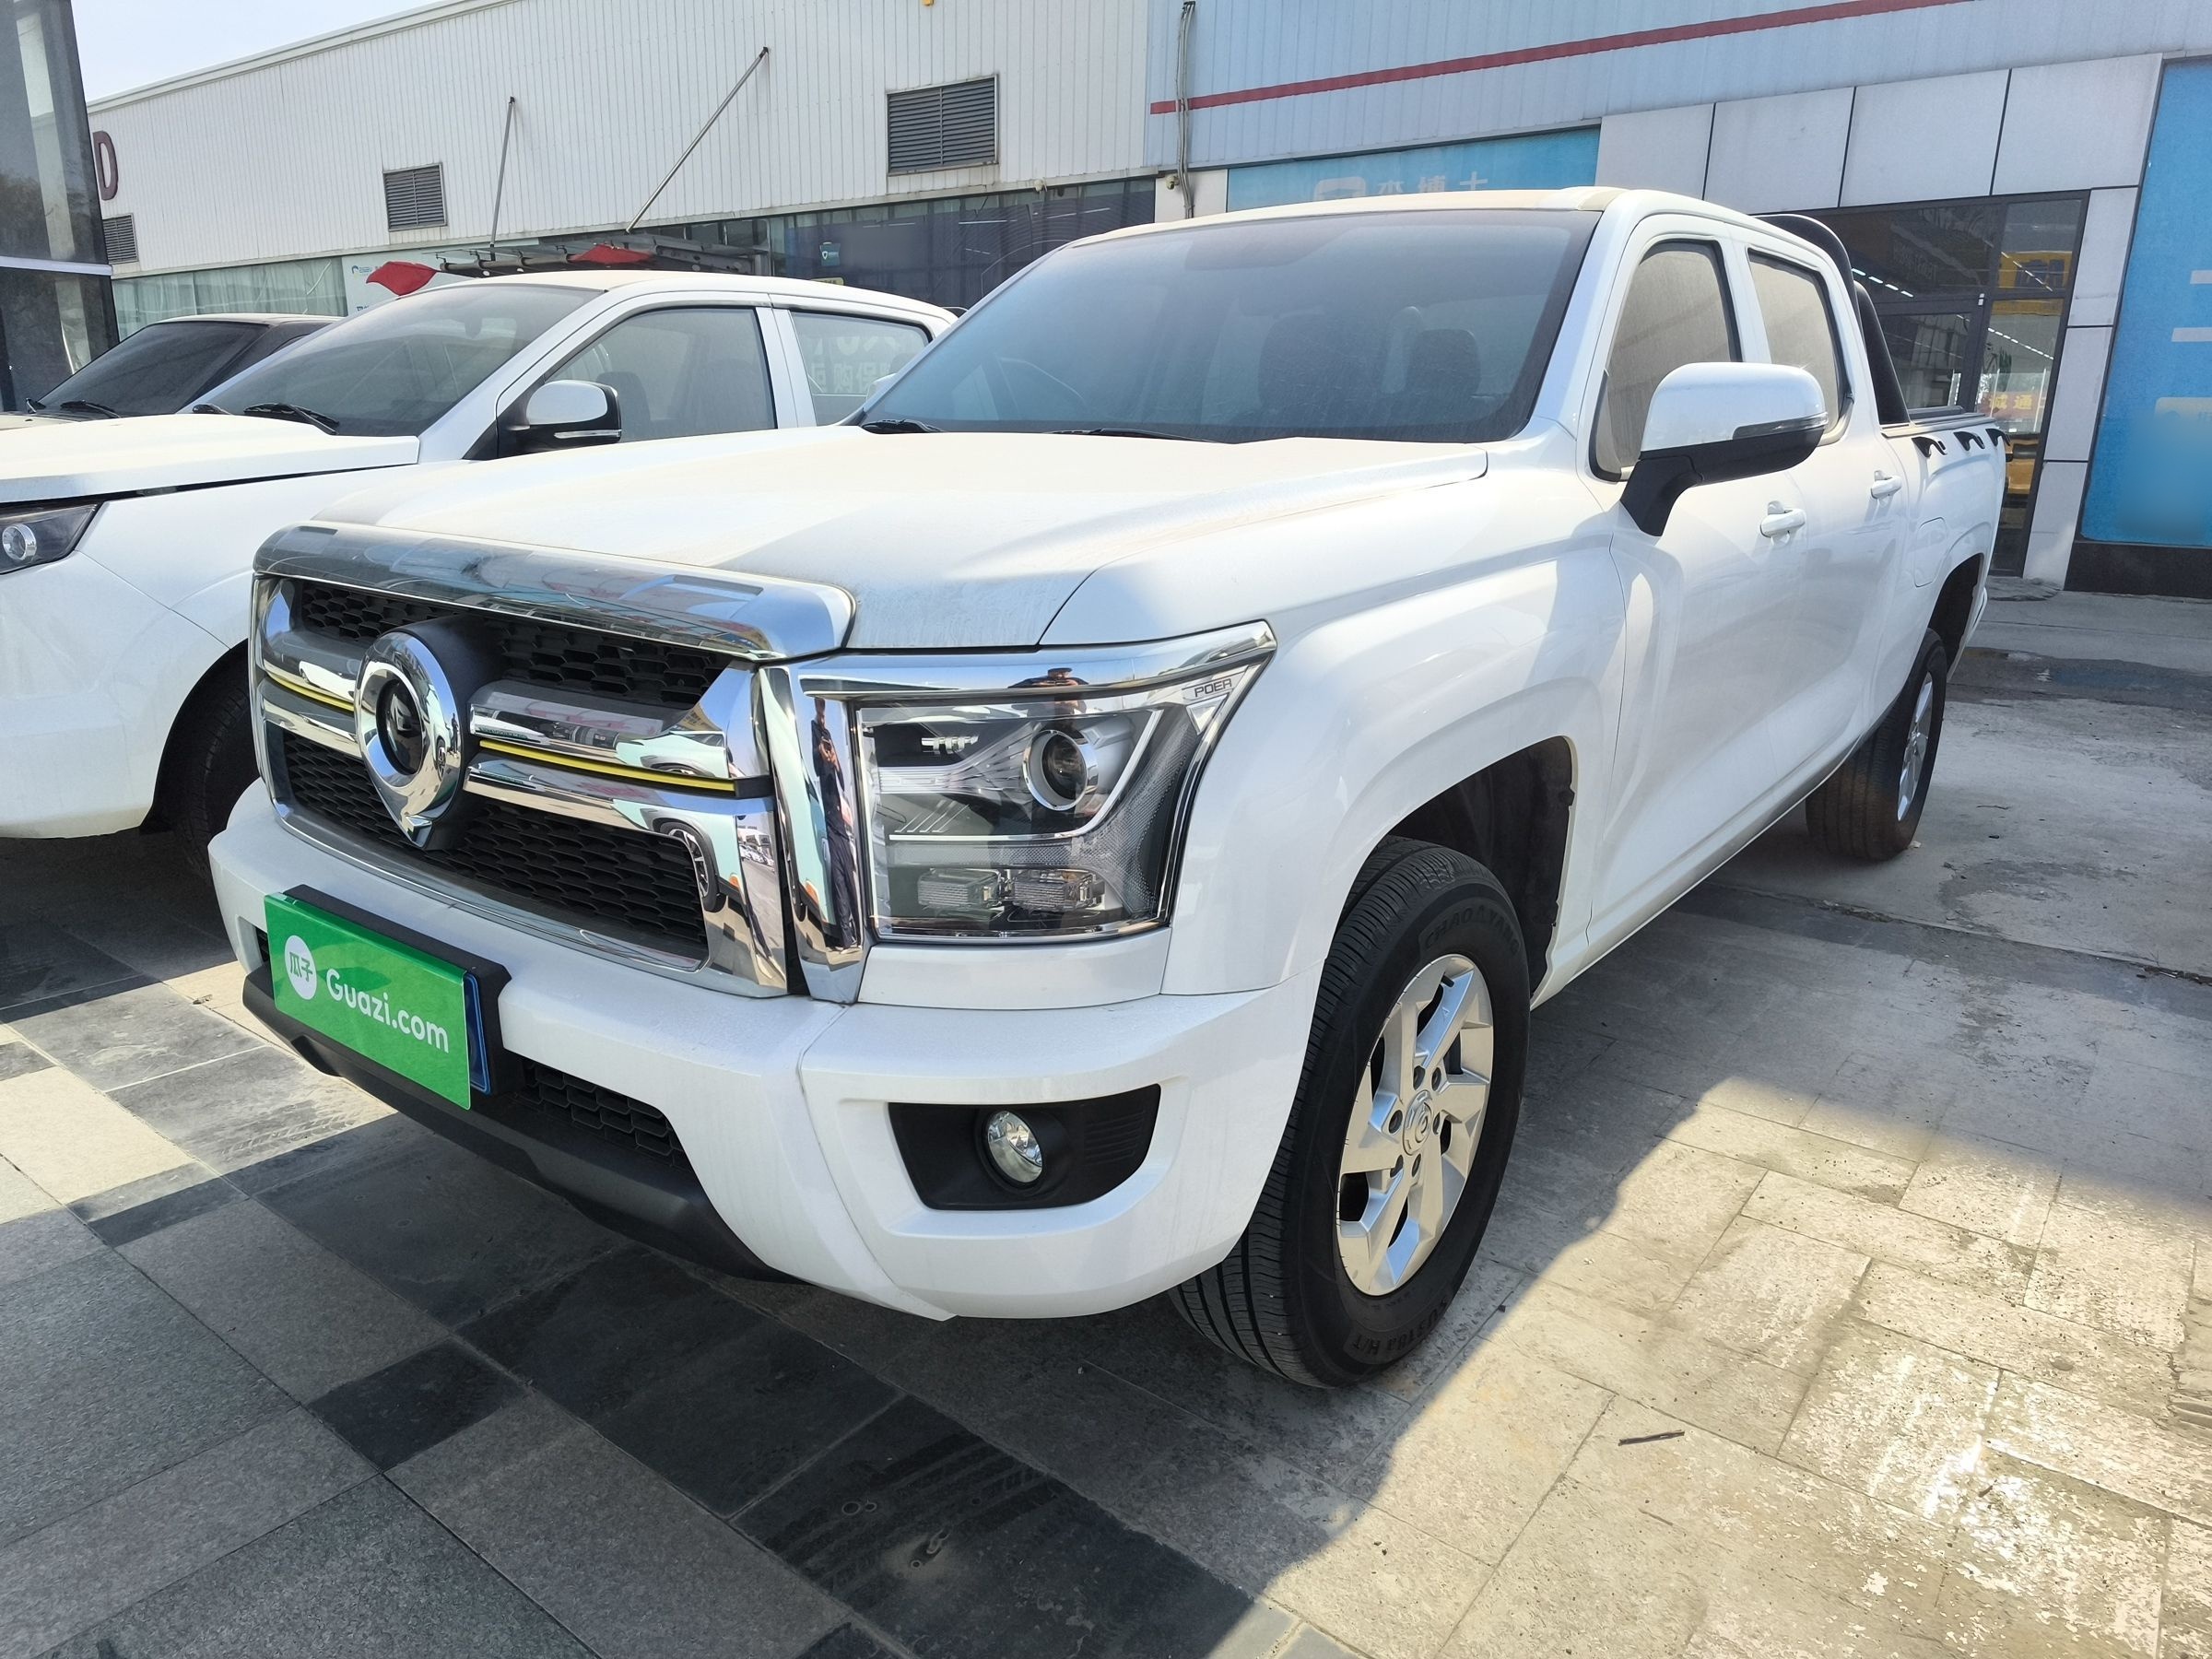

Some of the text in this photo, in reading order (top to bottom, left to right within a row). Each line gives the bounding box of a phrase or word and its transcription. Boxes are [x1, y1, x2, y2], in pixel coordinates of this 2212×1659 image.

[1194, 677, 1232, 698] POER
[288, 951, 313, 982] 瓜子
[326, 969, 449, 1053] Guazi.com
